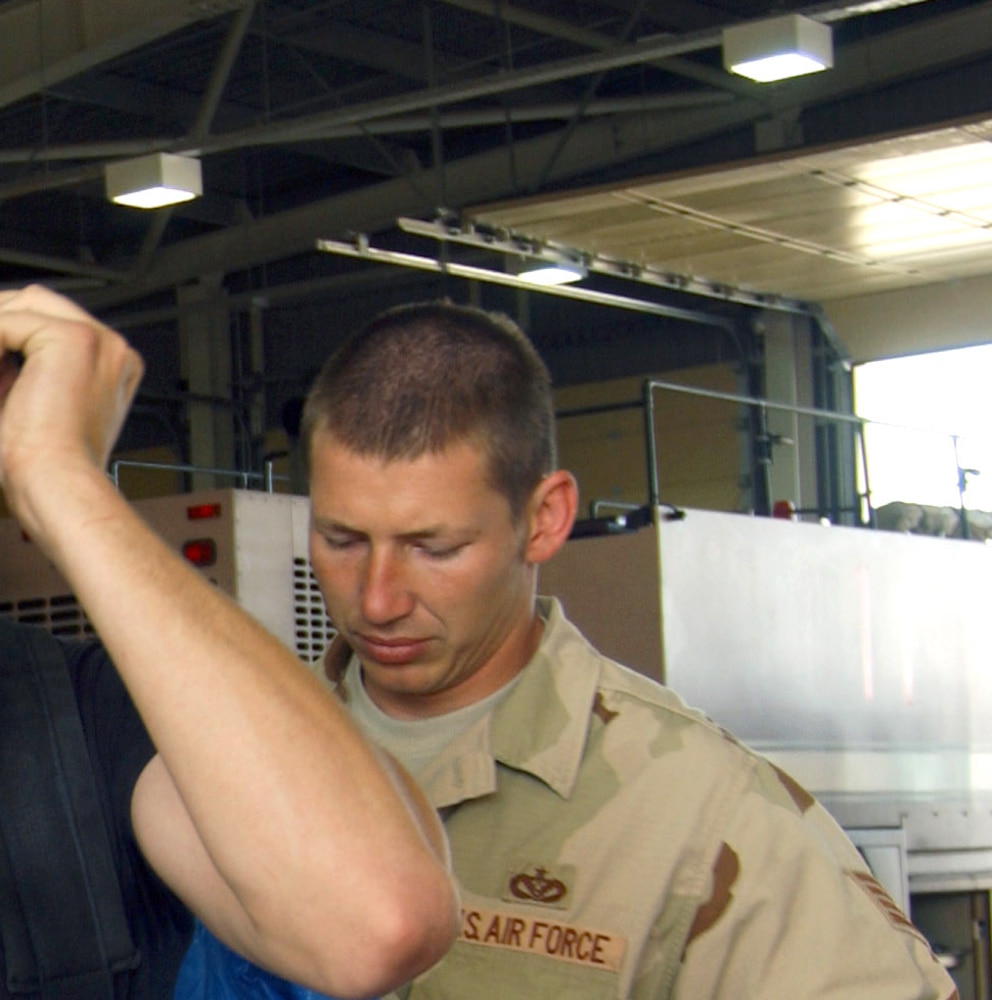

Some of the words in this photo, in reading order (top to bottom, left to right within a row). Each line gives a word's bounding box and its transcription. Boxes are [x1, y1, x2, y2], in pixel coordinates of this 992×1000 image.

[460, 909, 481, 941] S
[484, 914, 526, 947] AIR
[529, 921, 610, 964] FORCE
